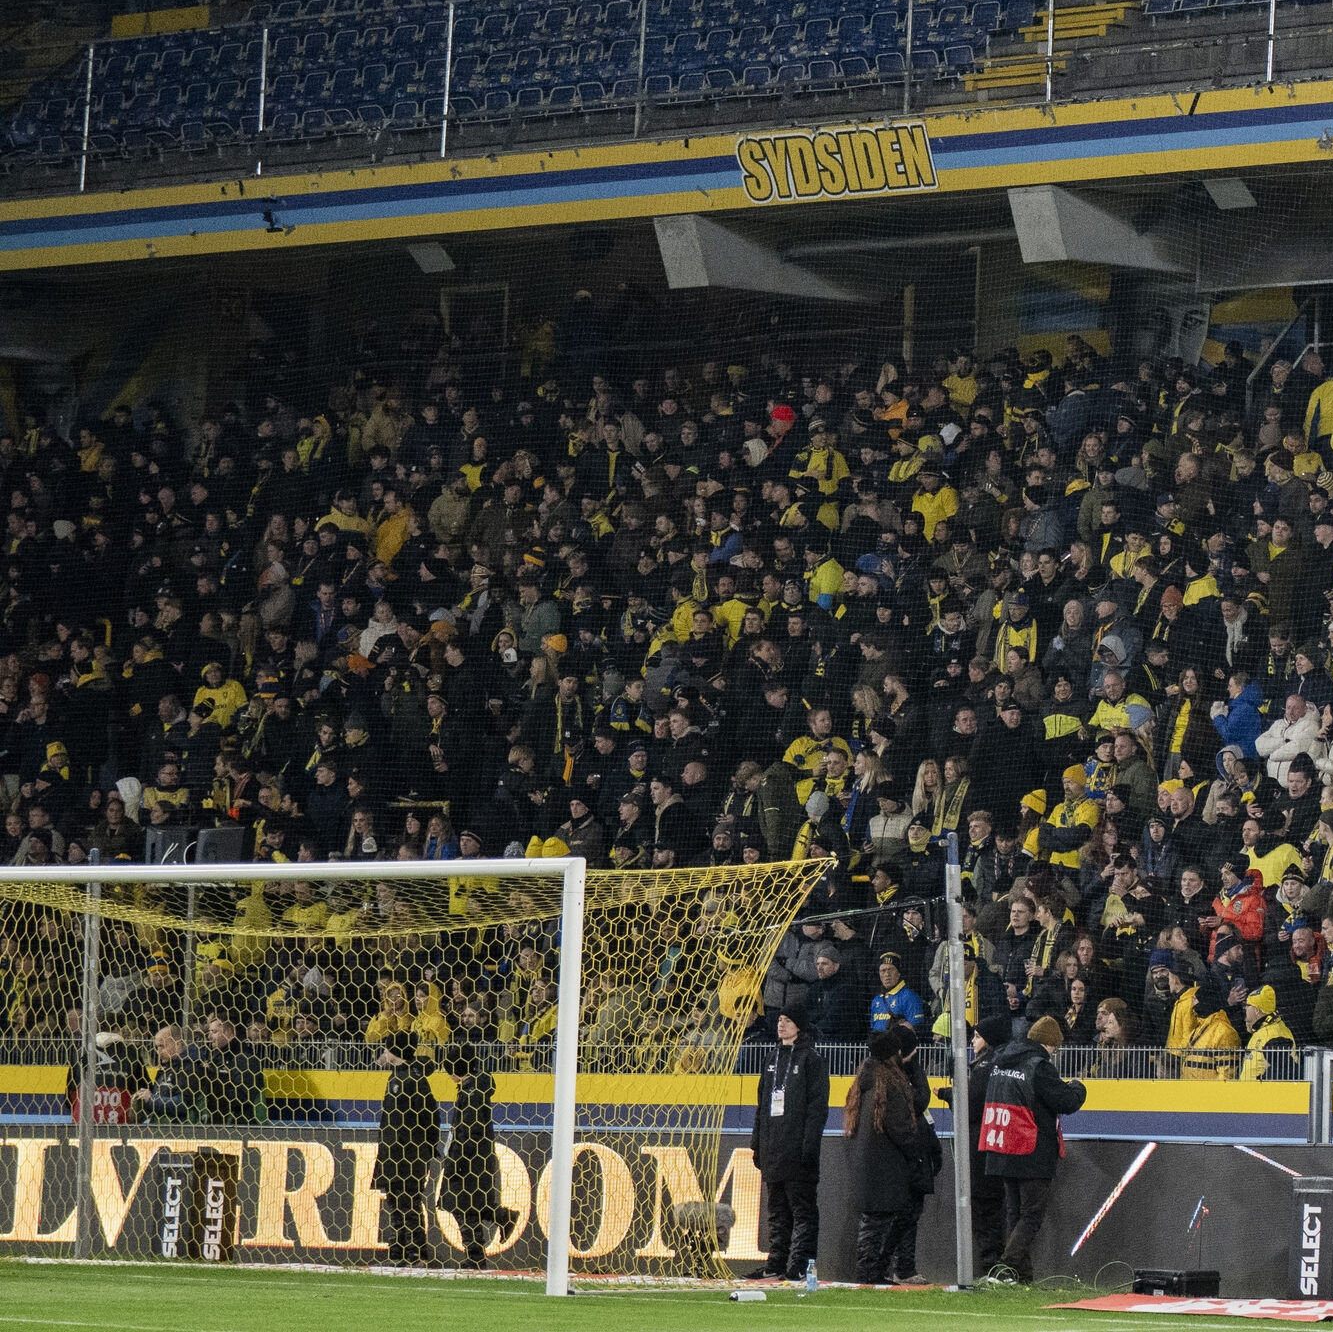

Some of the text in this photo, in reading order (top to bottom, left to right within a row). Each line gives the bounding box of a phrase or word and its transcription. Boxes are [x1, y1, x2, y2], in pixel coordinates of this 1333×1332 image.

[738, 125, 937, 201] SYDSIDEN
[986, 1129, 1005, 1148] 44
[162, 1175, 182, 1259] SELECT
[203, 1177, 225, 1261] SELECT
[1300, 1203, 1323, 1297] SELECT
